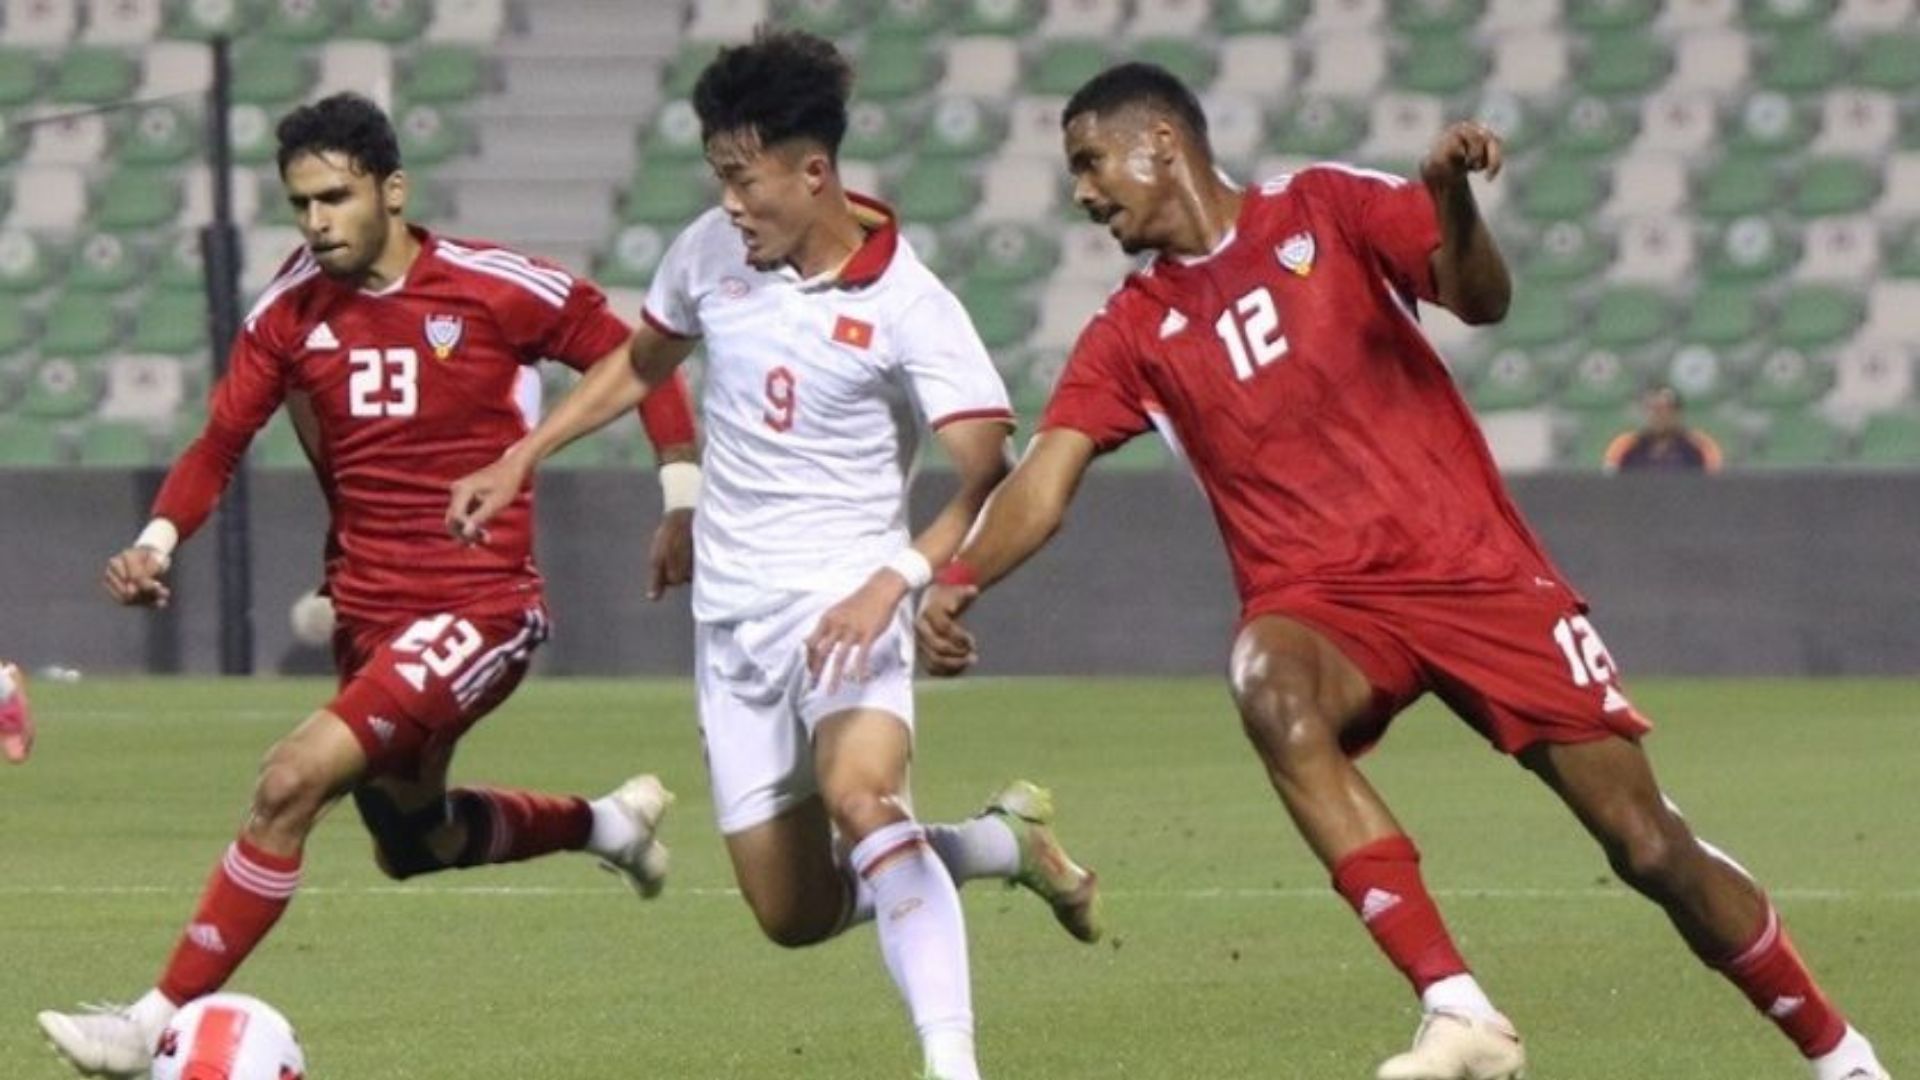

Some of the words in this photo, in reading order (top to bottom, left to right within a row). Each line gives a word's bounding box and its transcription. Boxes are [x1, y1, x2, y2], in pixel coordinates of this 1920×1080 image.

[1215, 287, 1289, 381] 12
[350, 348, 418, 417] 23
[763, 366, 795, 433] 9
[1553, 615, 1613, 686] 12
